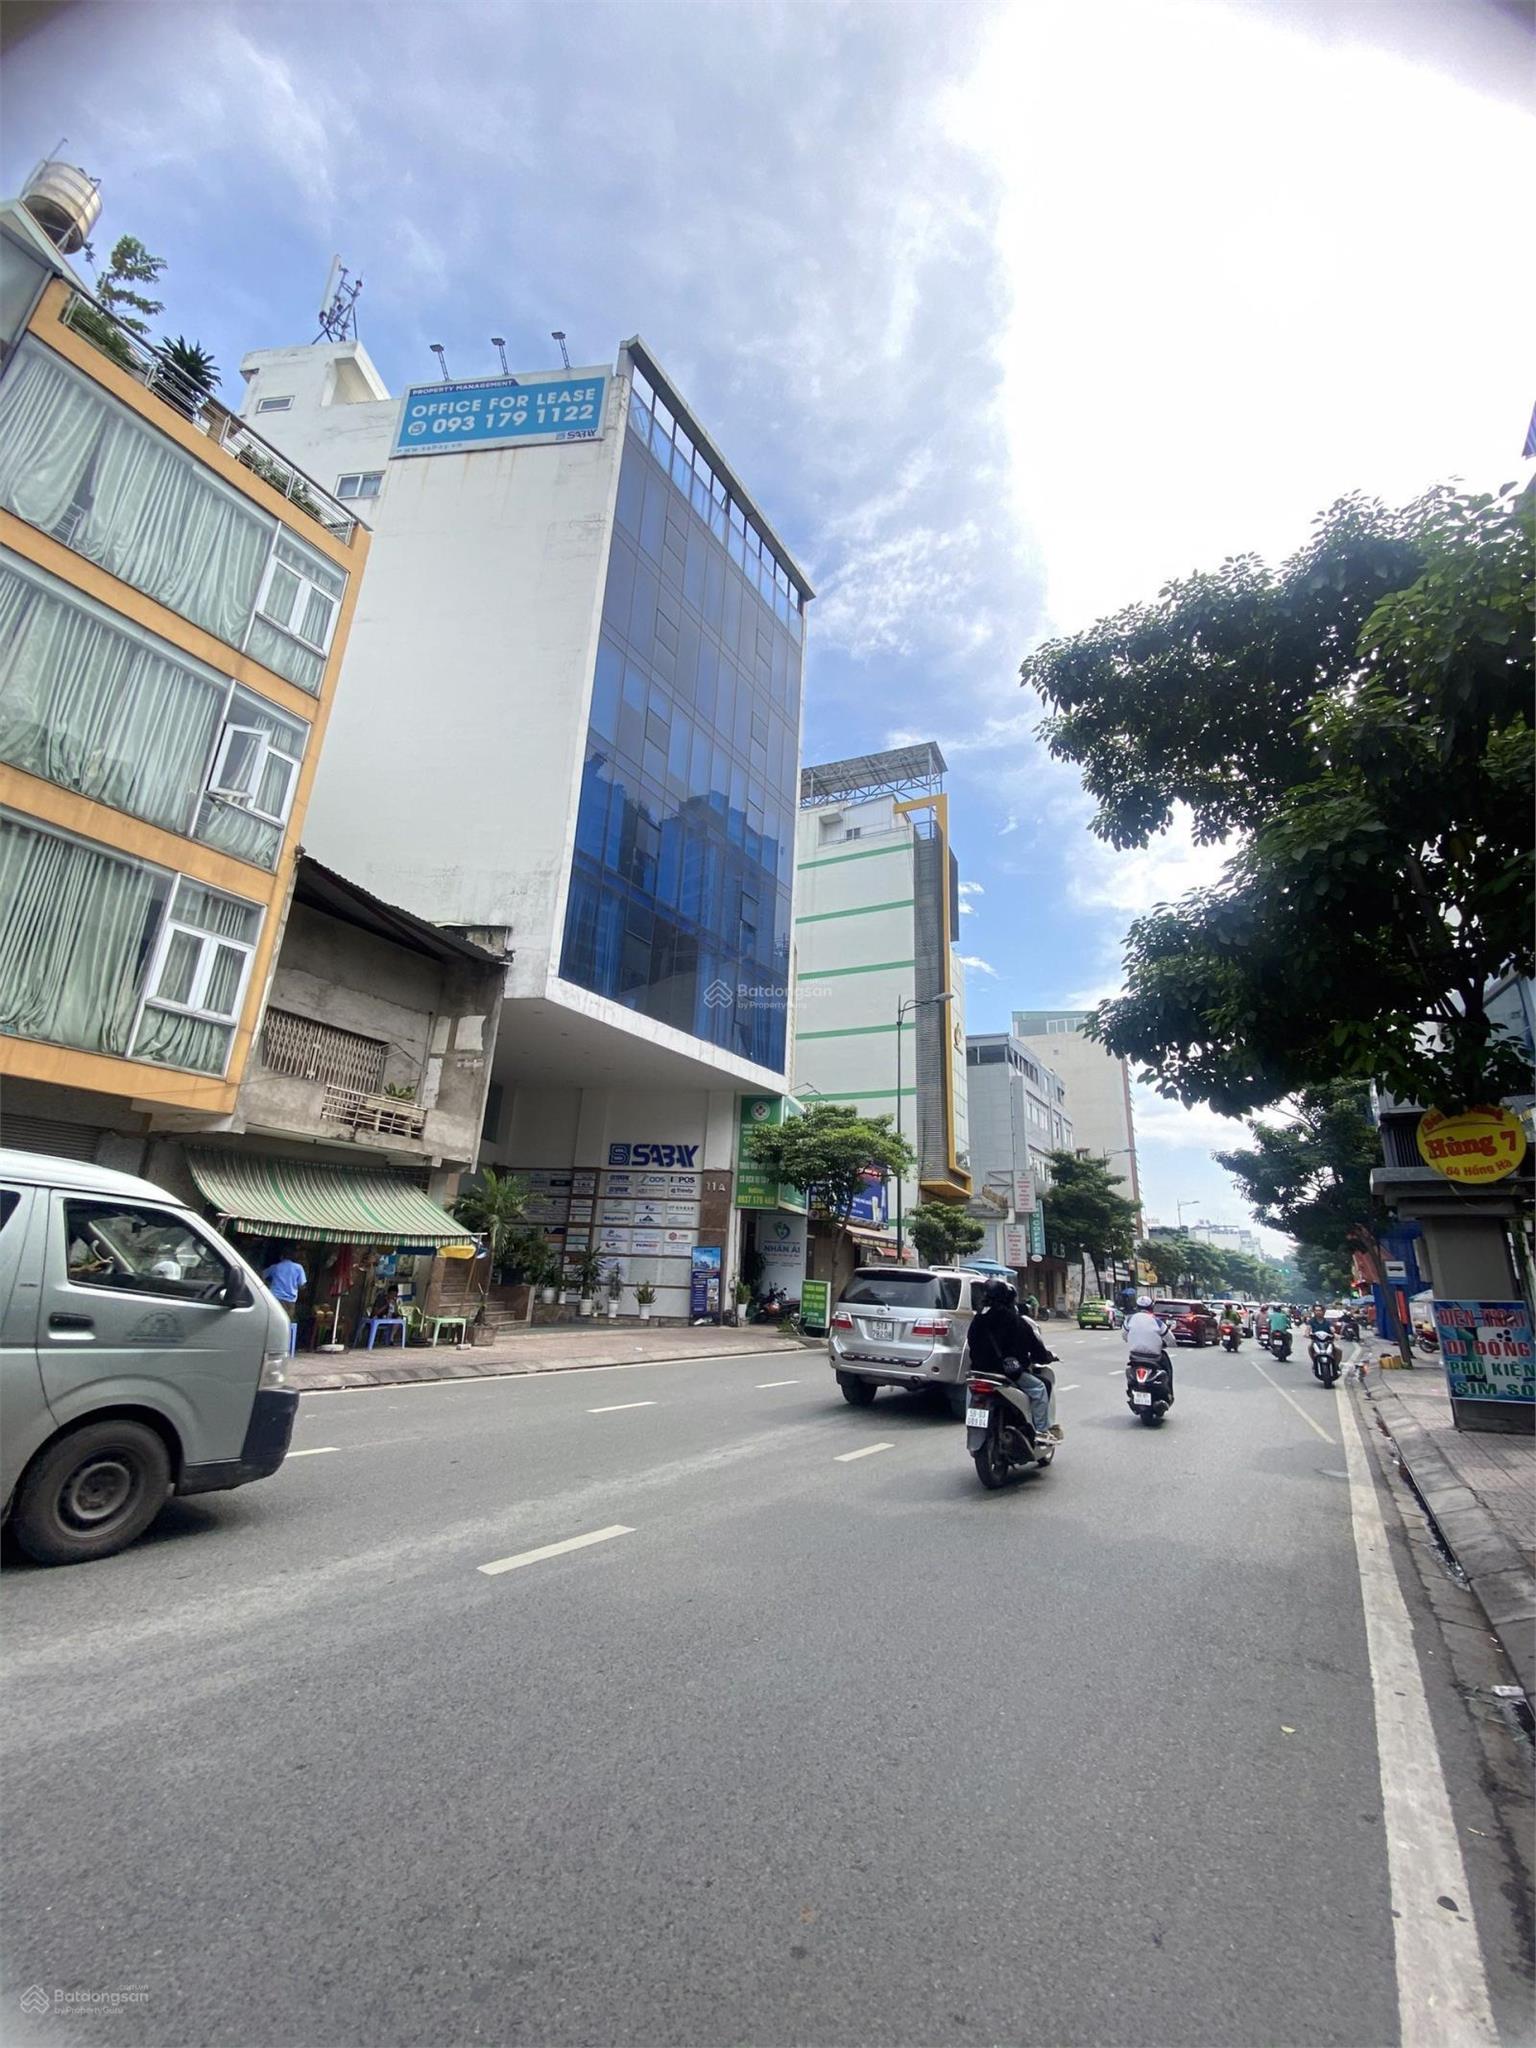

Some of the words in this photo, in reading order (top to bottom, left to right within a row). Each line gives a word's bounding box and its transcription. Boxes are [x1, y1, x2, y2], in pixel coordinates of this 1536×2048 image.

[412, 385, 454, 396] PROPERTY
[456, 380, 513, 392] MANAGEMENT
[412, 399, 482, 418] OFFICE
[488, 395, 529, 410] FOR
[536, 388, 596, 405] LEASE
[432, 416, 476, 434] 093
[486, 410, 528, 429] 179
[536, 404, 594, 424] 1122
[631, 1143, 700, 1168] SABAY
[1424, 1136, 1498, 1159] Hùng
[1500, 1130, 1517, 1151] 7
[705, 1181, 726, 1192] 11A
[1447, 1340, 1467, 1356] DI
[1474, 1338, 1531, 1360] ĐỘNG
[1449, 1361, 1484, 1379] PHỤ
[1491, 1361, 1536, 1379] KIỆN
[1455, 1382, 1497, 1395] SIM
